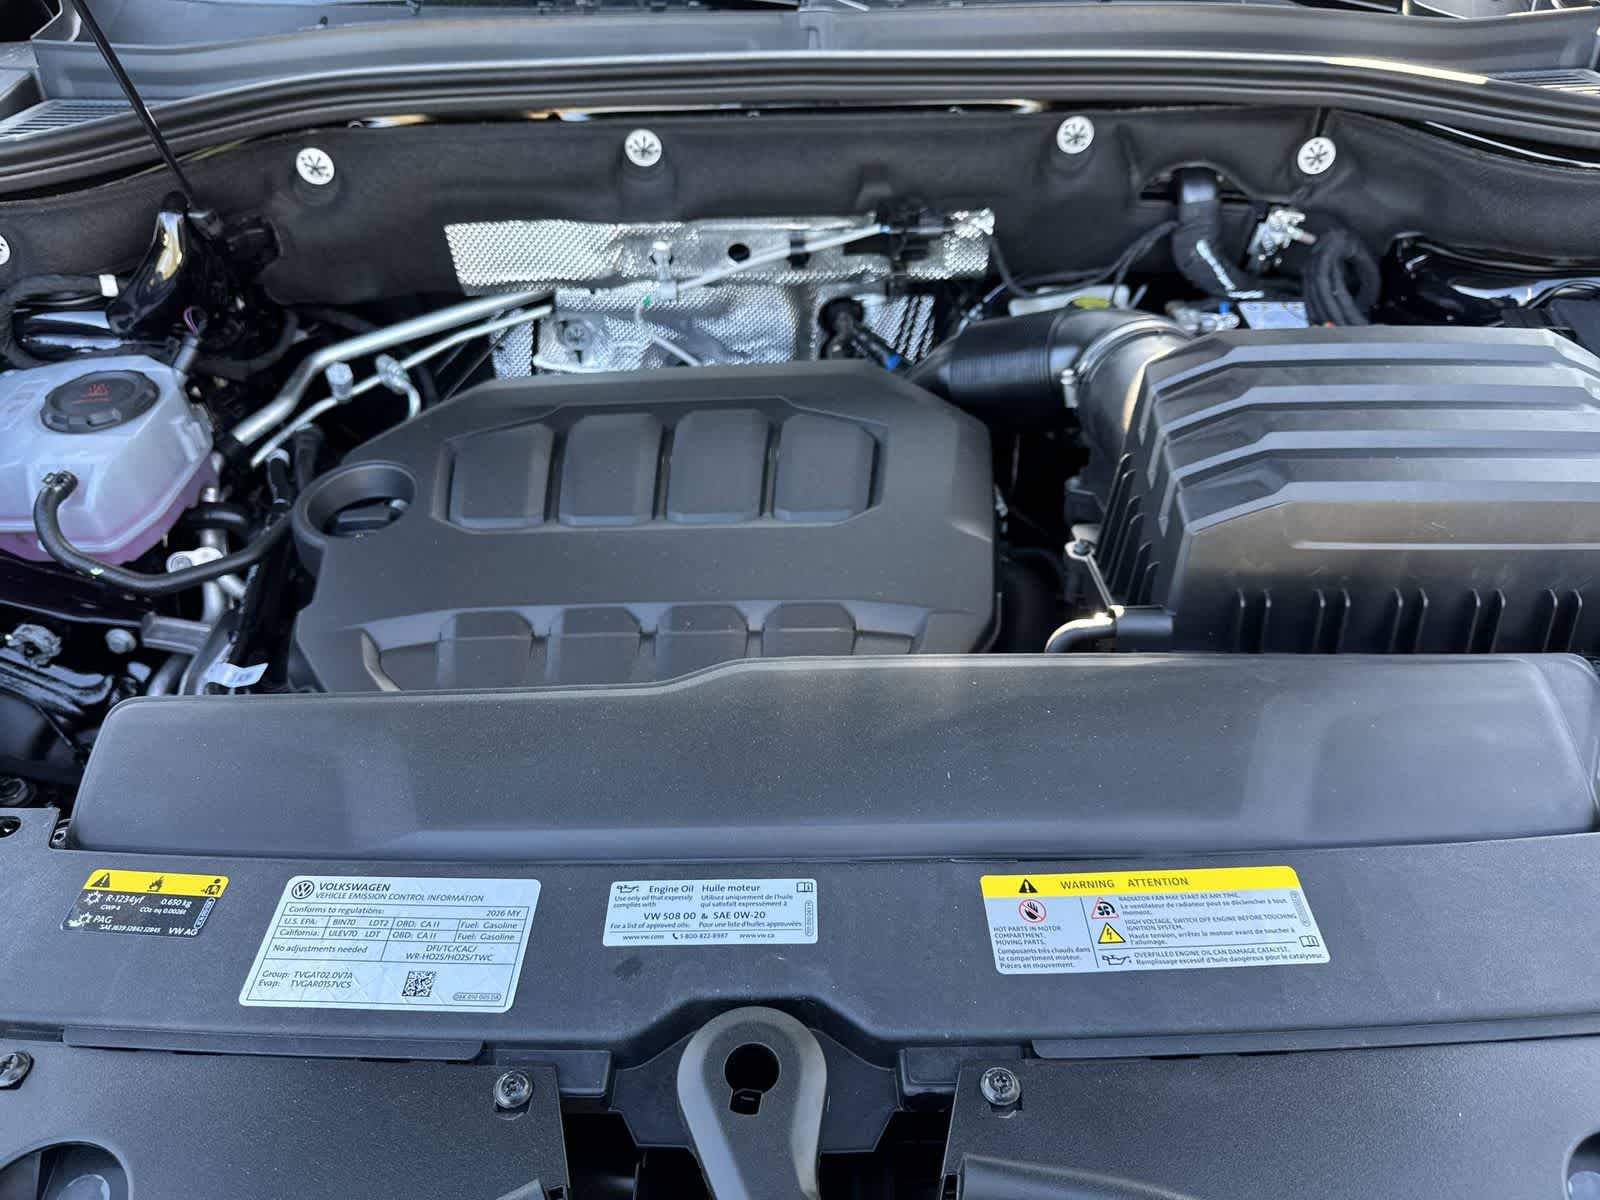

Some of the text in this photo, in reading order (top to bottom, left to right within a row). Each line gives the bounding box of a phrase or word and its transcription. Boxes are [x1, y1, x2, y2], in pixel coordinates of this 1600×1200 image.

[319, 882, 391, 892] VOLKSWAGEN
[702, 884, 726, 892] Huile
[1060, 876, 1189, 890] WARNING ATTENTION
[648, 884, 694, 894] Engine Oil
[105, 894, 146, 906] R-1234yf
[315, 892, 348, 900] VEHICLE
[348, 892, 388, 900] EMISSION
[160, 898, 192, 908] 0.650 kg
[337, 906, 385, 915] regulations:
[486, 909, 506, 917] 2026
[644, 912, 661, 920] VW
[663, 912, 681, 920] 508
[682, 912, 696, 920] 00
[713, 911, 732, 920] SAE
[733, 911, 766, 920] 0W-20
[93, 914, 112, 924] PAG
[420, 920, 434, 928] CA
[460, 920, 479, 929] Fuel:
[483, 921, 518, 930] Gasoline
[168, 927, 198, 936] VW AG
[280, 928, 320, 937] California:
[364, 930, 380, 938] LDT
[458, 932, 476, 940] Fuel:
[480, 932, 515, 941] Gasoline
[272, 944, 368, 954] No adjustments needed
[426, 944, 479, 953] DFI/TC/CAC/
[1229, 955, 1265, 963] dangereux
[262, 970, 290, 980] Group:
[258, 979, 281, 988] Evap:
